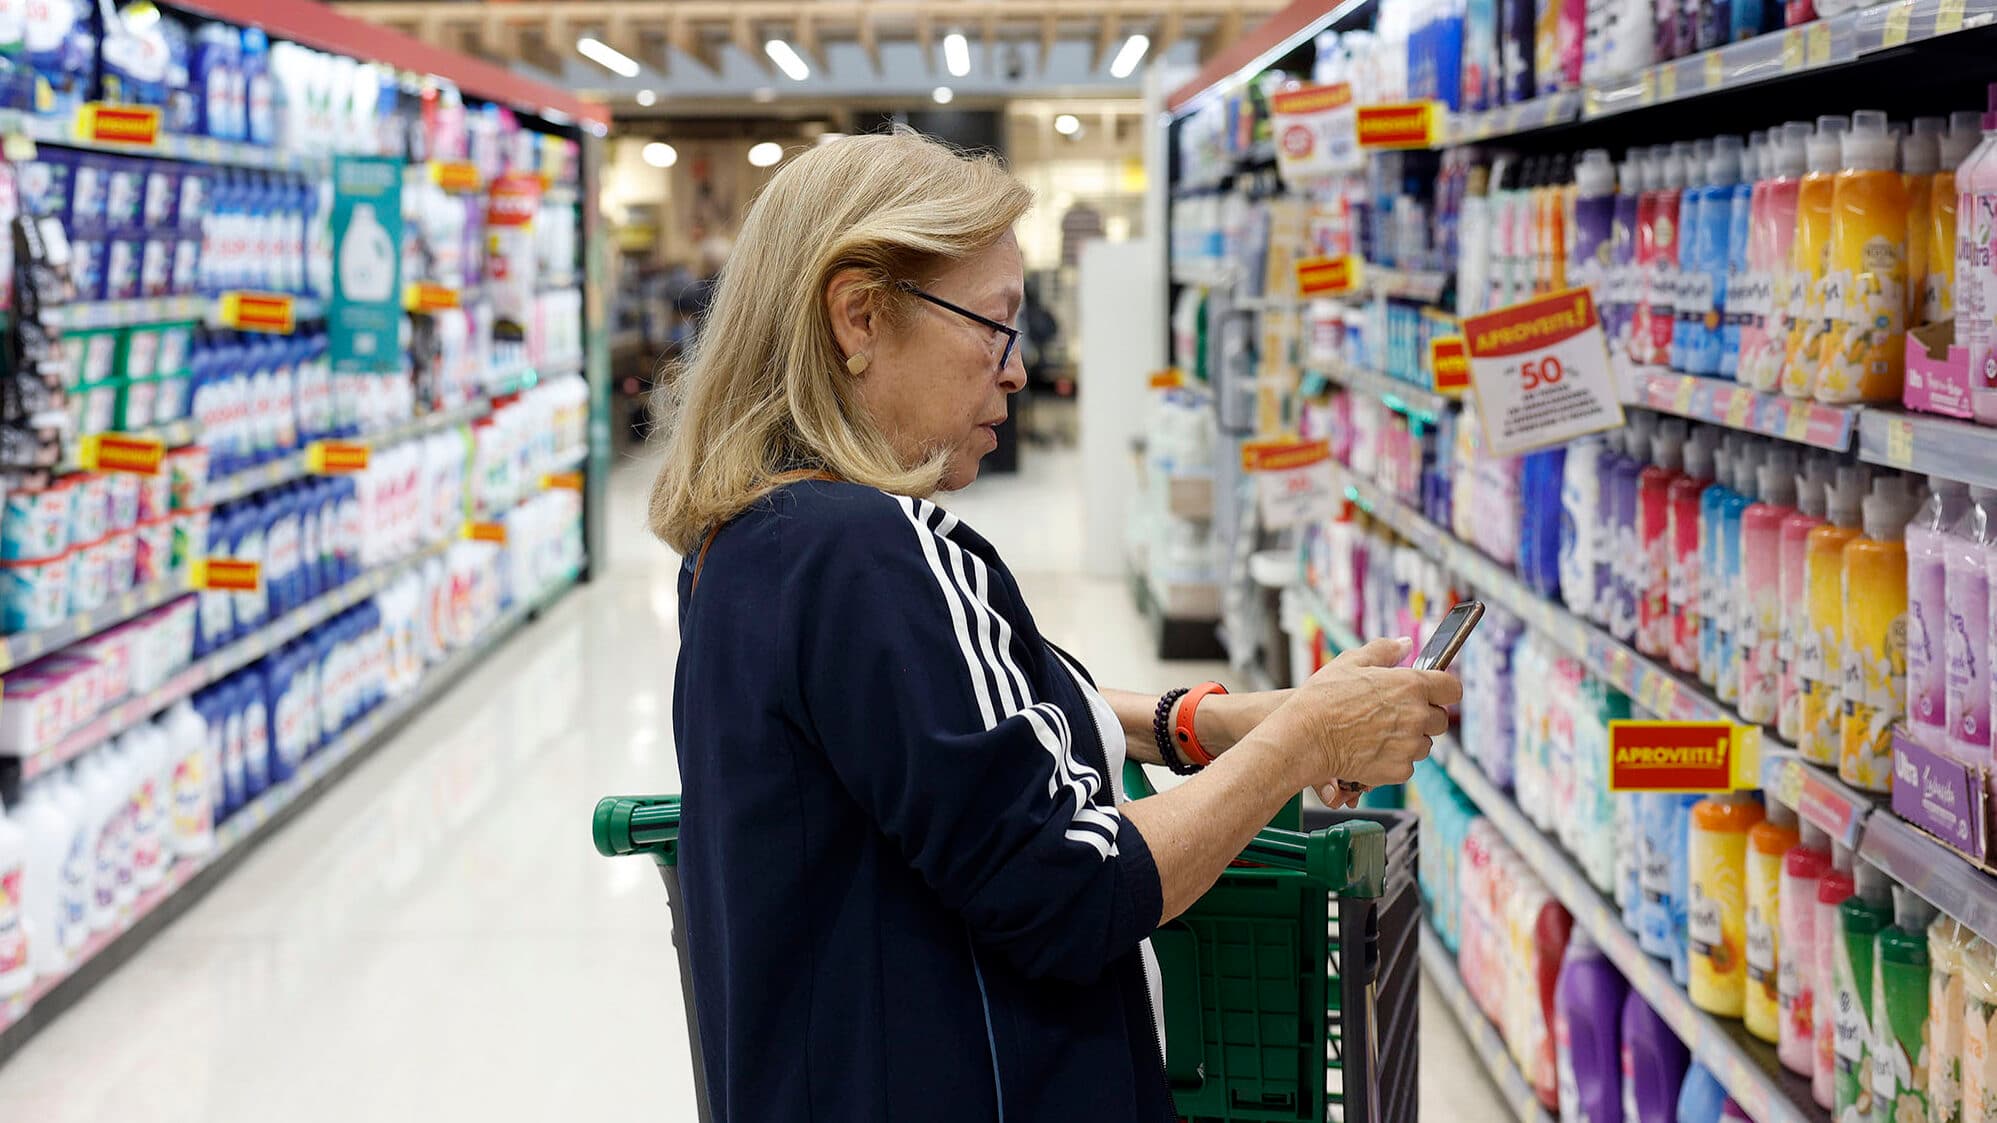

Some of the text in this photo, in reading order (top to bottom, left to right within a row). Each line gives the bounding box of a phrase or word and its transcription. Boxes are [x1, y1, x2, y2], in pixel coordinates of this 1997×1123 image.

[1475, 297, 1587, 352] APROVEITE!
[1520, 355, 1563, 391] 50
[1616, 737, 1729, 766] APROVEITE!
